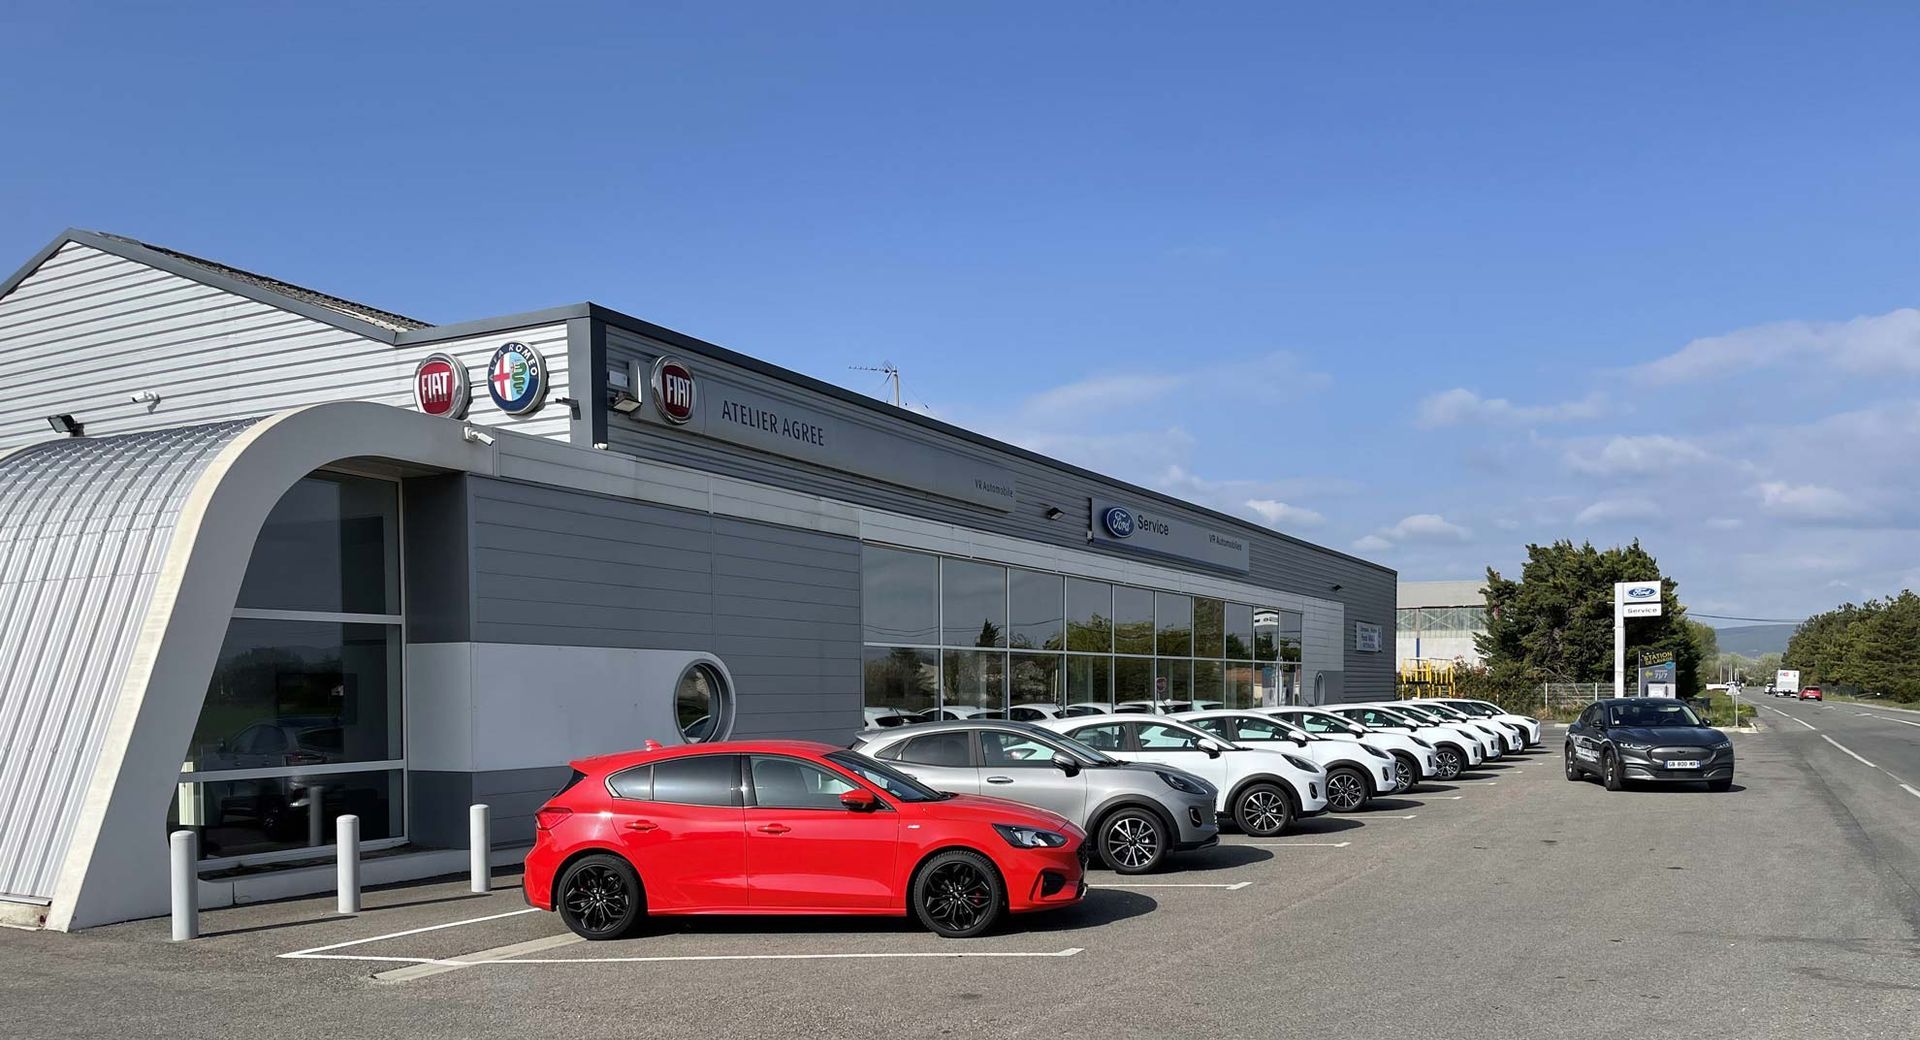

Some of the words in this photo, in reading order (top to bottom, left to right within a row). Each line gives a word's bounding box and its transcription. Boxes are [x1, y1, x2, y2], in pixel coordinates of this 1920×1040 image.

[508, 343, 538, 376] ROMEO
[421, 372, 450, 404] FIAT
[665, 374, 691, 408] FIAT
[722, 400, 778, 433] ATELIER
[782, 418, 824, 446] AGREE
[1112, 511, 1131, 531] Ford
[1137, 514, 1169, 536] Service
[1643, 651, 1673, 662] STATION
